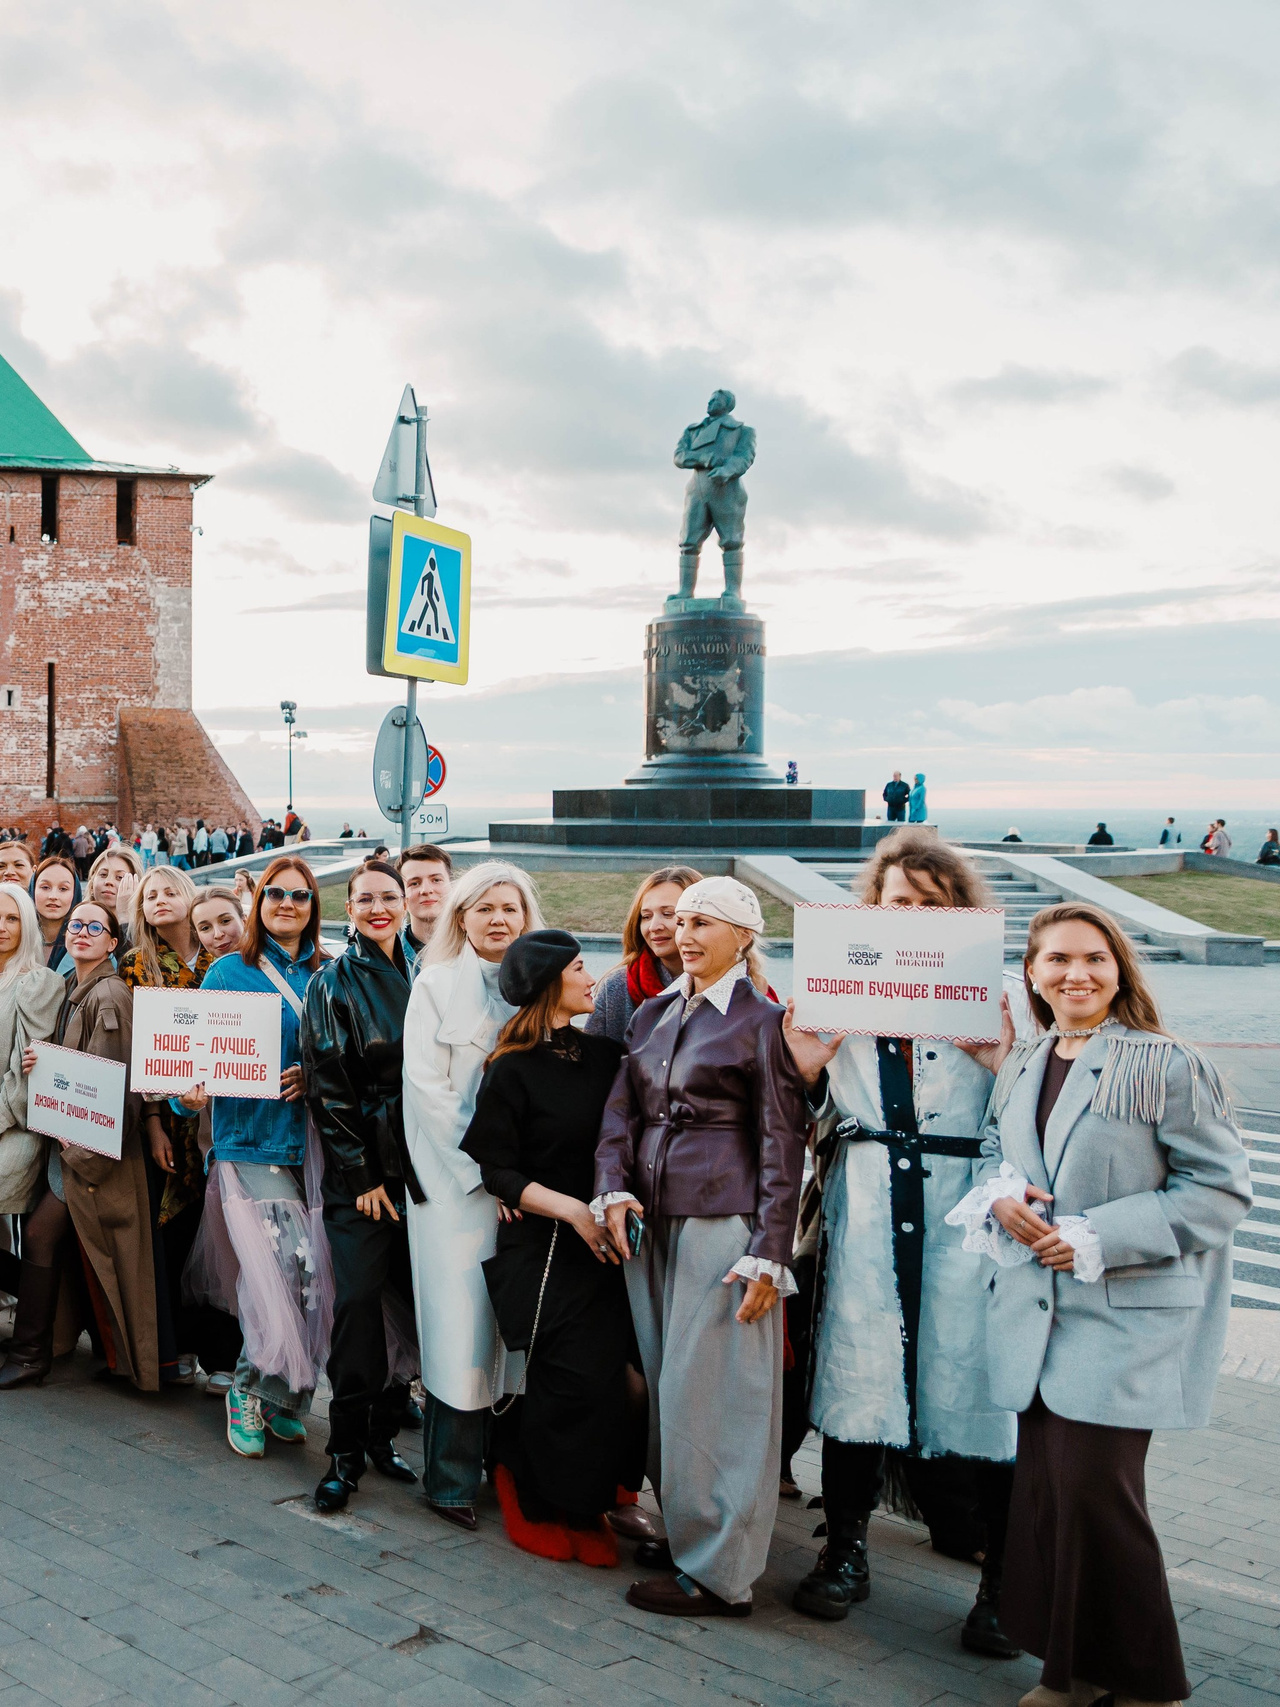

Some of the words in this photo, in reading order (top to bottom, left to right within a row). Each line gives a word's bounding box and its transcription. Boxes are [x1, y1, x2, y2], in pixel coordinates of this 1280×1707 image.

[848, 951, 883, 959] НОВЫЕ
[895, 959, 944, 968] НИЖНИЙ
[896, 950, 944, 959] МОДНЫЙ
[807, 978, 864, 996] СОЗДАЕМ
[869, 981, 929, 1000] БУДУЩЕЕ
[934, 984, 988, 1002] ВМЕСТЕ
[153, 1033, 190, 1052] НАШЕ
[210, 1036, 260, 1058] ЛУЧШЕ,
[145, 1058, 193, 1077] НАШИМ
[213, 1062, 267, 1081] ЛУЧШЕЕ
[34, 1094, 58, 1111] ДИЗАЙН
[61, 1101, 65, 1113] С
[67, 1104, 88, 1120] ДУШОЙ
[90, 1111, 115, 1129] РОССИИ
